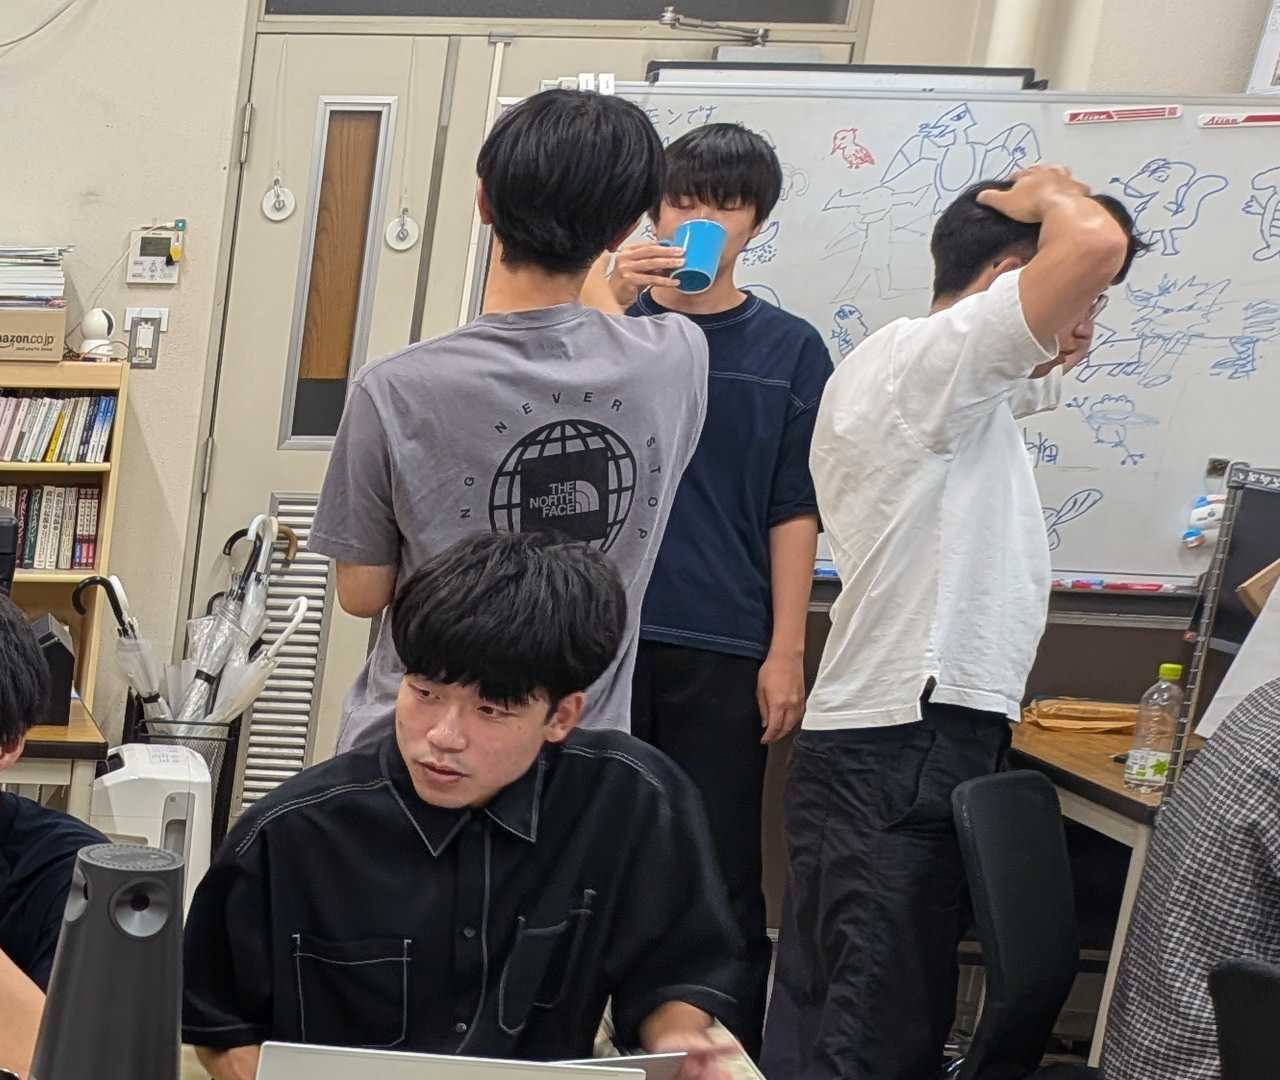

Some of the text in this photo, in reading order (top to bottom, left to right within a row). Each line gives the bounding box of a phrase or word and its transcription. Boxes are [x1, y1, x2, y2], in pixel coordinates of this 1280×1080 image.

[493, 391, 624, 435] NEVER
[548, 479, 576, 494] THE
[638, 436, 663, 540] STOP
[529, 491, 576, 510] NORTH
[542, 503, 576, 518] FACE
